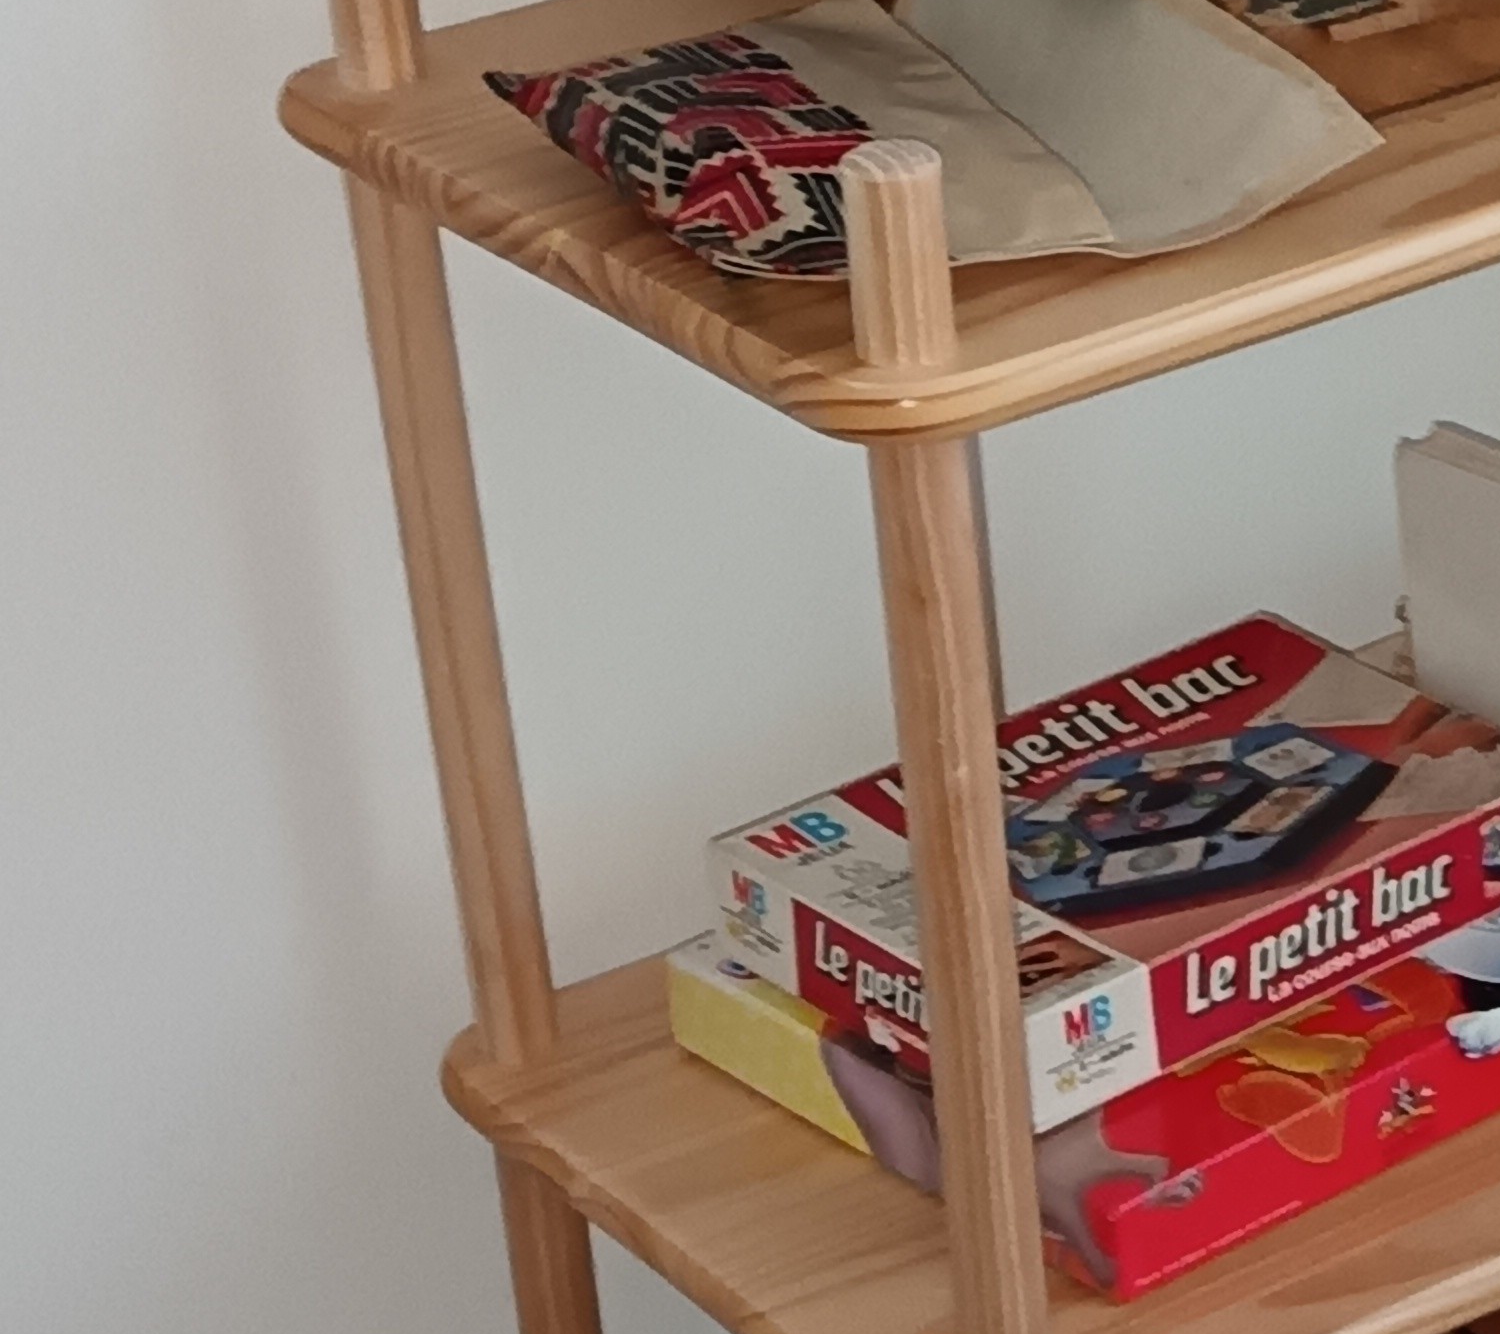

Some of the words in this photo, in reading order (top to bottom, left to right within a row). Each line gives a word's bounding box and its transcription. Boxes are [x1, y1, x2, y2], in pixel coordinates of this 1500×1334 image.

[1121, 654, 1259, 718] bac
[744, 811, 847, 859] MB
[814, 919, 850, 983] Le
[1186, 951, 1238, 1015] Le
[1248, 888, 1361, 1001] petit
[1371, 853, 1453, 928] bac
